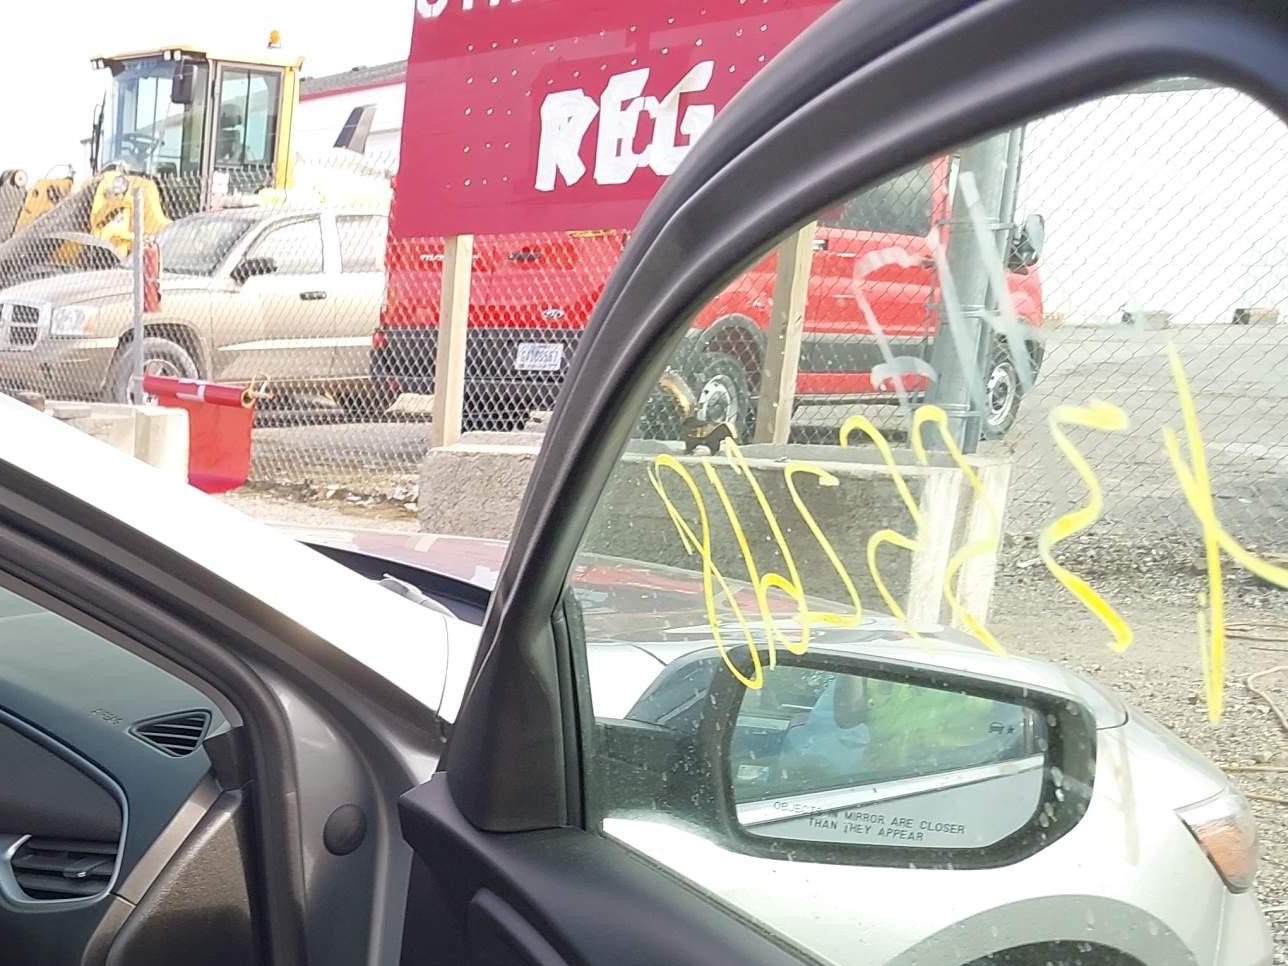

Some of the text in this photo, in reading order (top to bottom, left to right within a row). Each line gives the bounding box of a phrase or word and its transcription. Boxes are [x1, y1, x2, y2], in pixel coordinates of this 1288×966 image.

[808, 817, 925, 842] THAN THEY APPEAR
[844, 812, 885, 825] MIRROR
[891, 817, 913, 829] ARE
[919, 820, 966, 835] CLOSER
